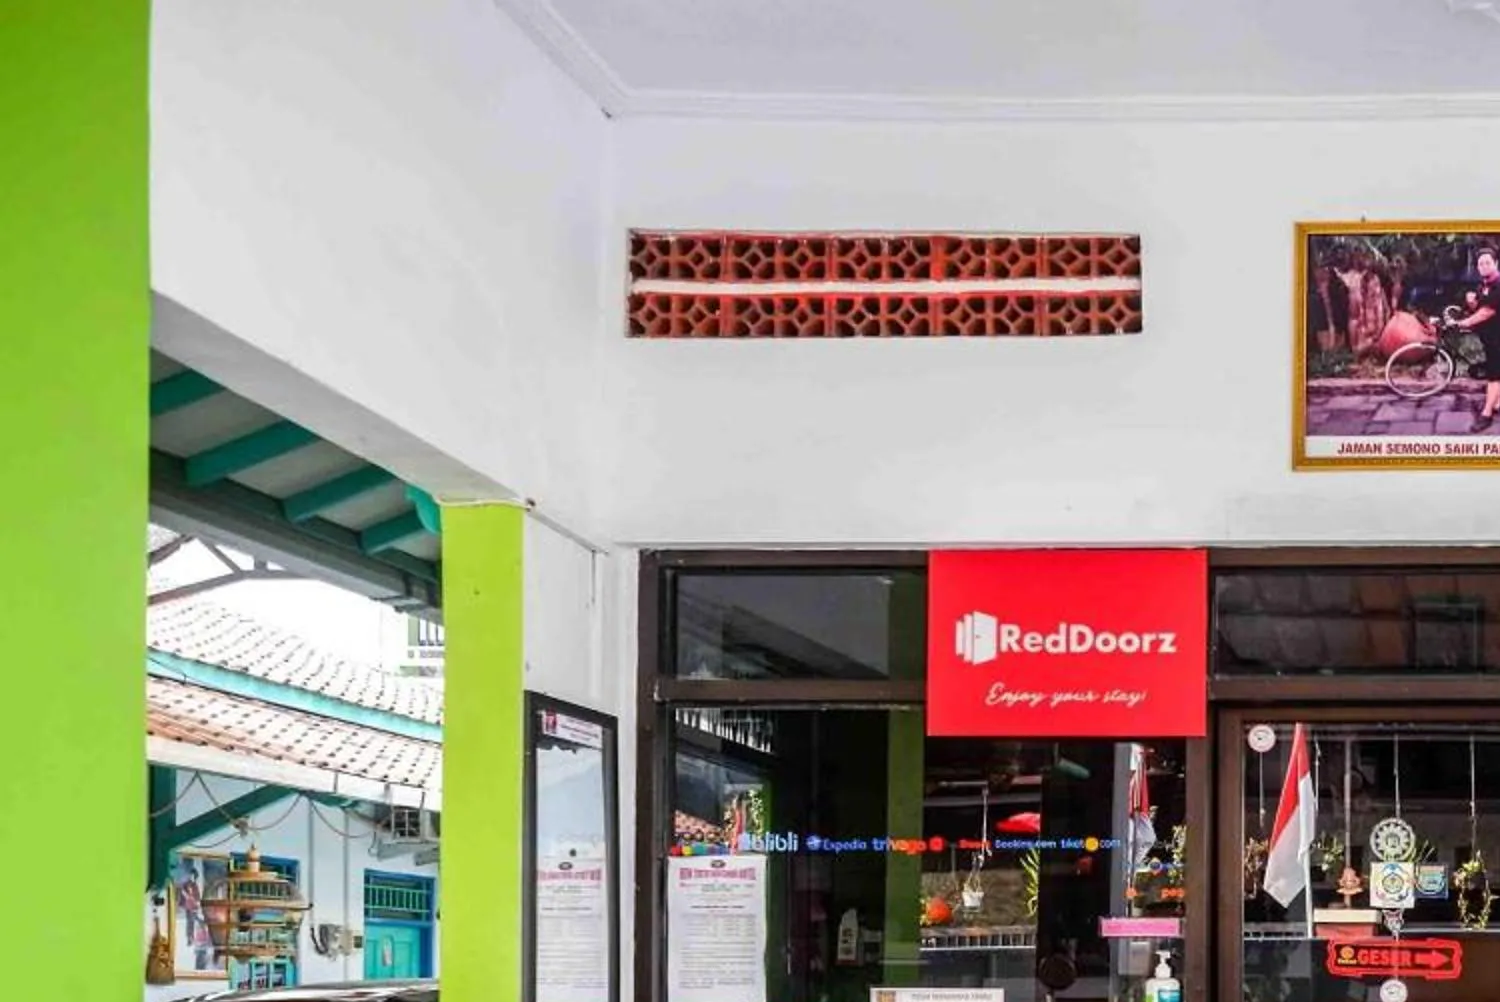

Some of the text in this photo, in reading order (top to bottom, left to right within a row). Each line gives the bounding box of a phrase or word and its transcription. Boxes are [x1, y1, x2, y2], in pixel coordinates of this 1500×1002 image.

[1337, 442, 1382, 455] JAMAN
[1385, 442, 1441, 455] SEMONO
[1445, 442, 1479, 455] SAIKI
[1000, 621, 1177, 654] RedDoorz
[985, 681, 1048, 708] Enjoy
[1050, 690, 1102, 708] your
[872, 837, 927, 855] trivago
